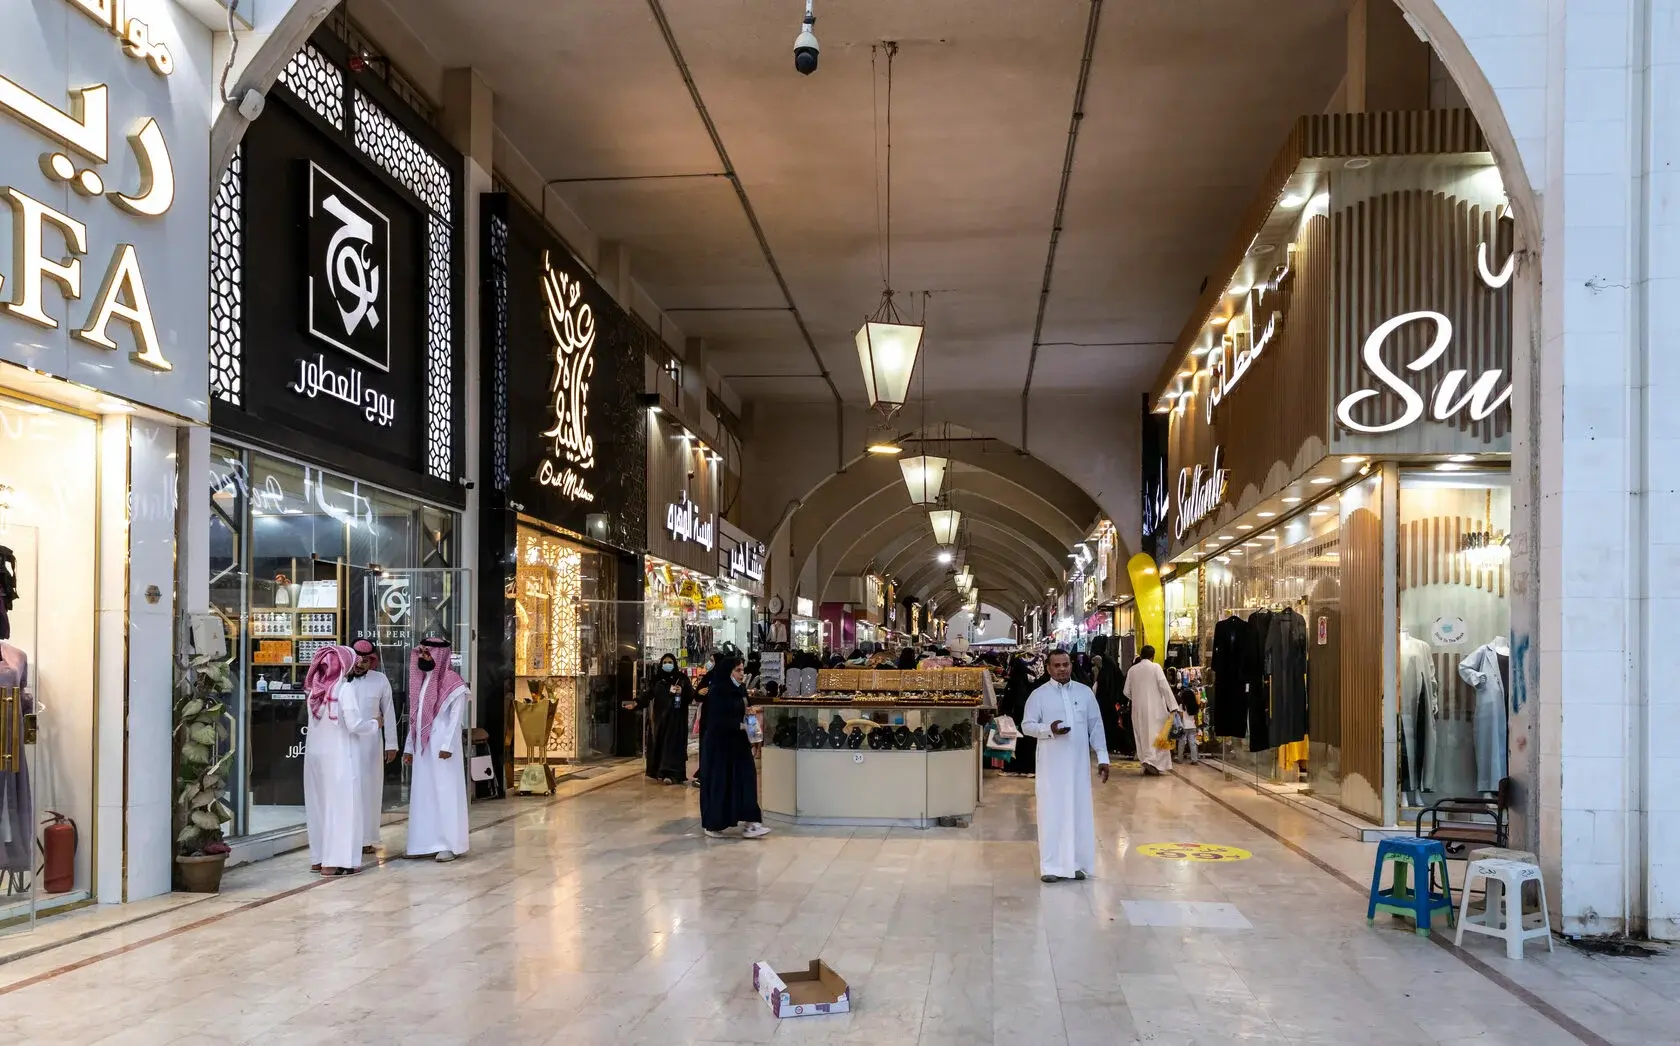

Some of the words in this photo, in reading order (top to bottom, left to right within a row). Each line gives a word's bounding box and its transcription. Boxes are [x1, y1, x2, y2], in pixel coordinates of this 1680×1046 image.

[0, 184, 174, 372] FA
[293, 353, 362, 406] للعطور
[364, 388, 395, 428] بوج
[1336, 310, 1513, 433] Su
